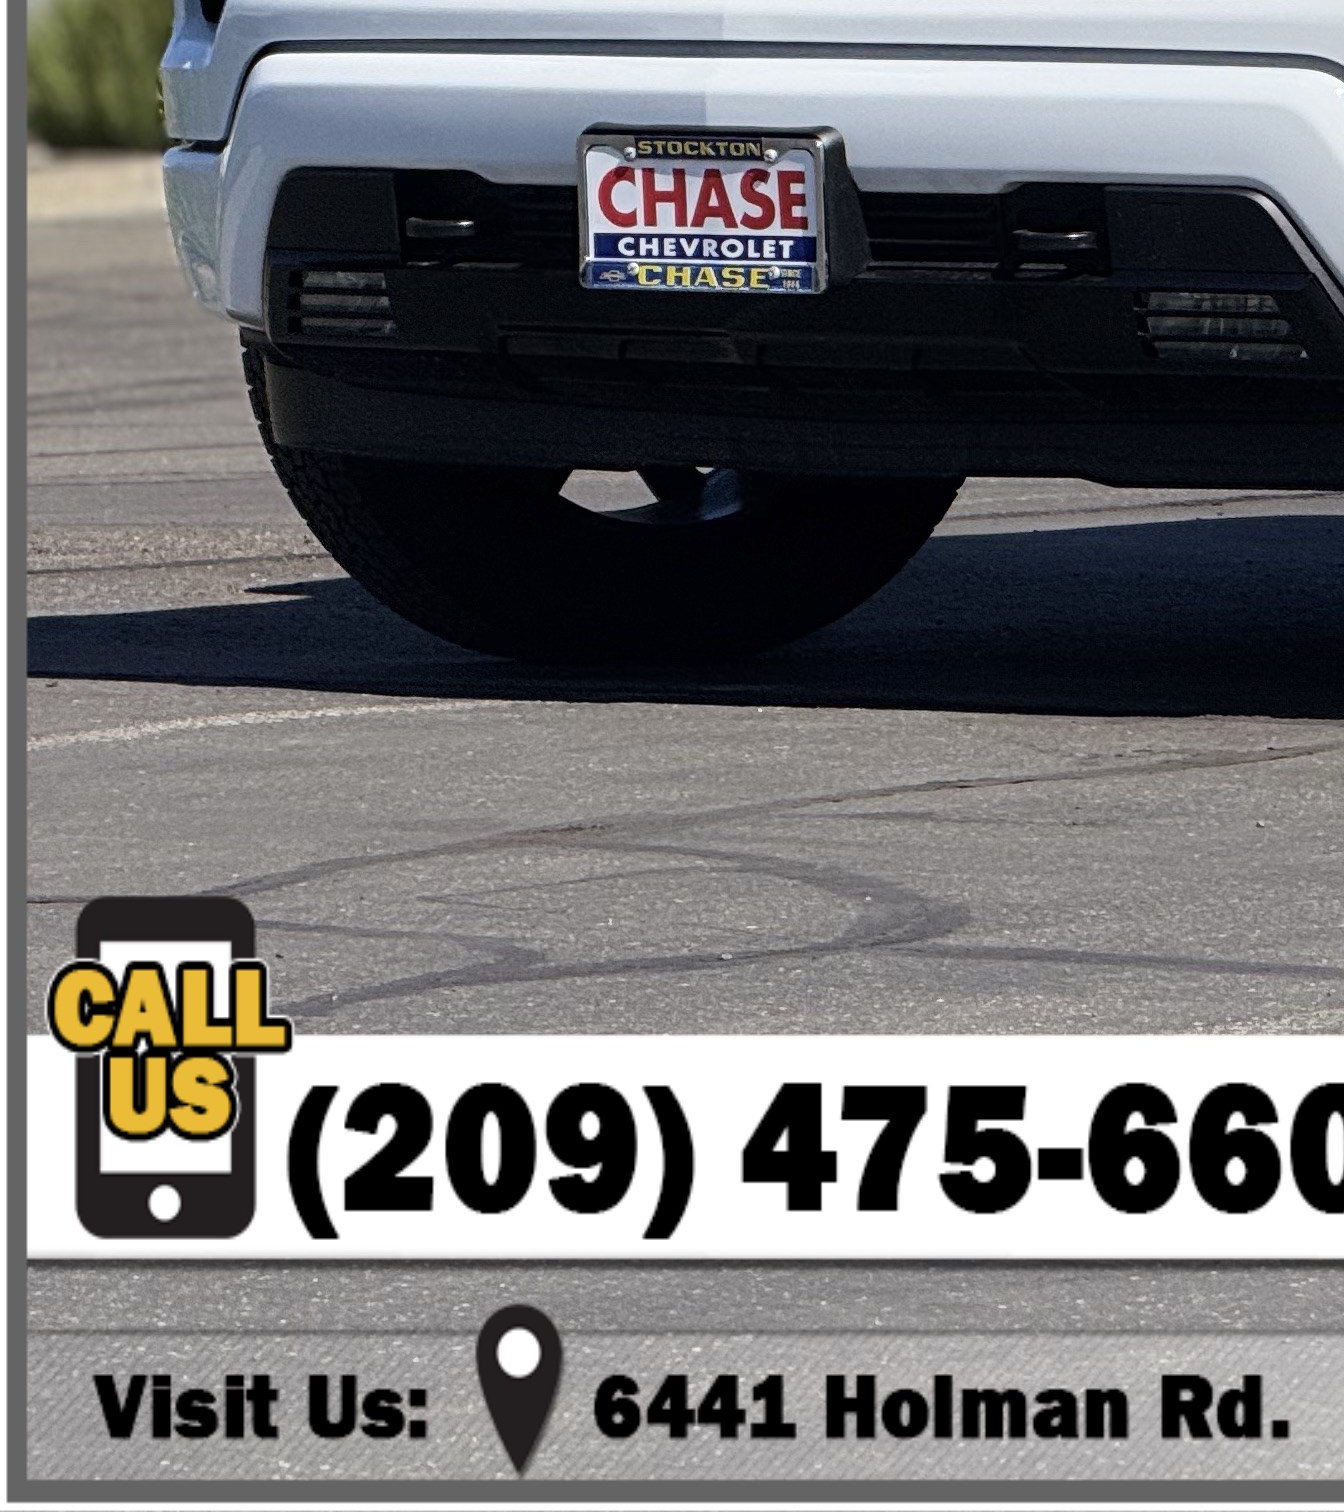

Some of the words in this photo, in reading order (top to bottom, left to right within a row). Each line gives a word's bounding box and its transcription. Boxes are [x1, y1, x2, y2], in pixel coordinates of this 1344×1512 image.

[636, 141, 761, 157] STOCKTON
[598, 166, 809, 230] CHASE
[617, 237, 794, 259] CHEVROLET
[637, 265, 770, 288] CHASE
